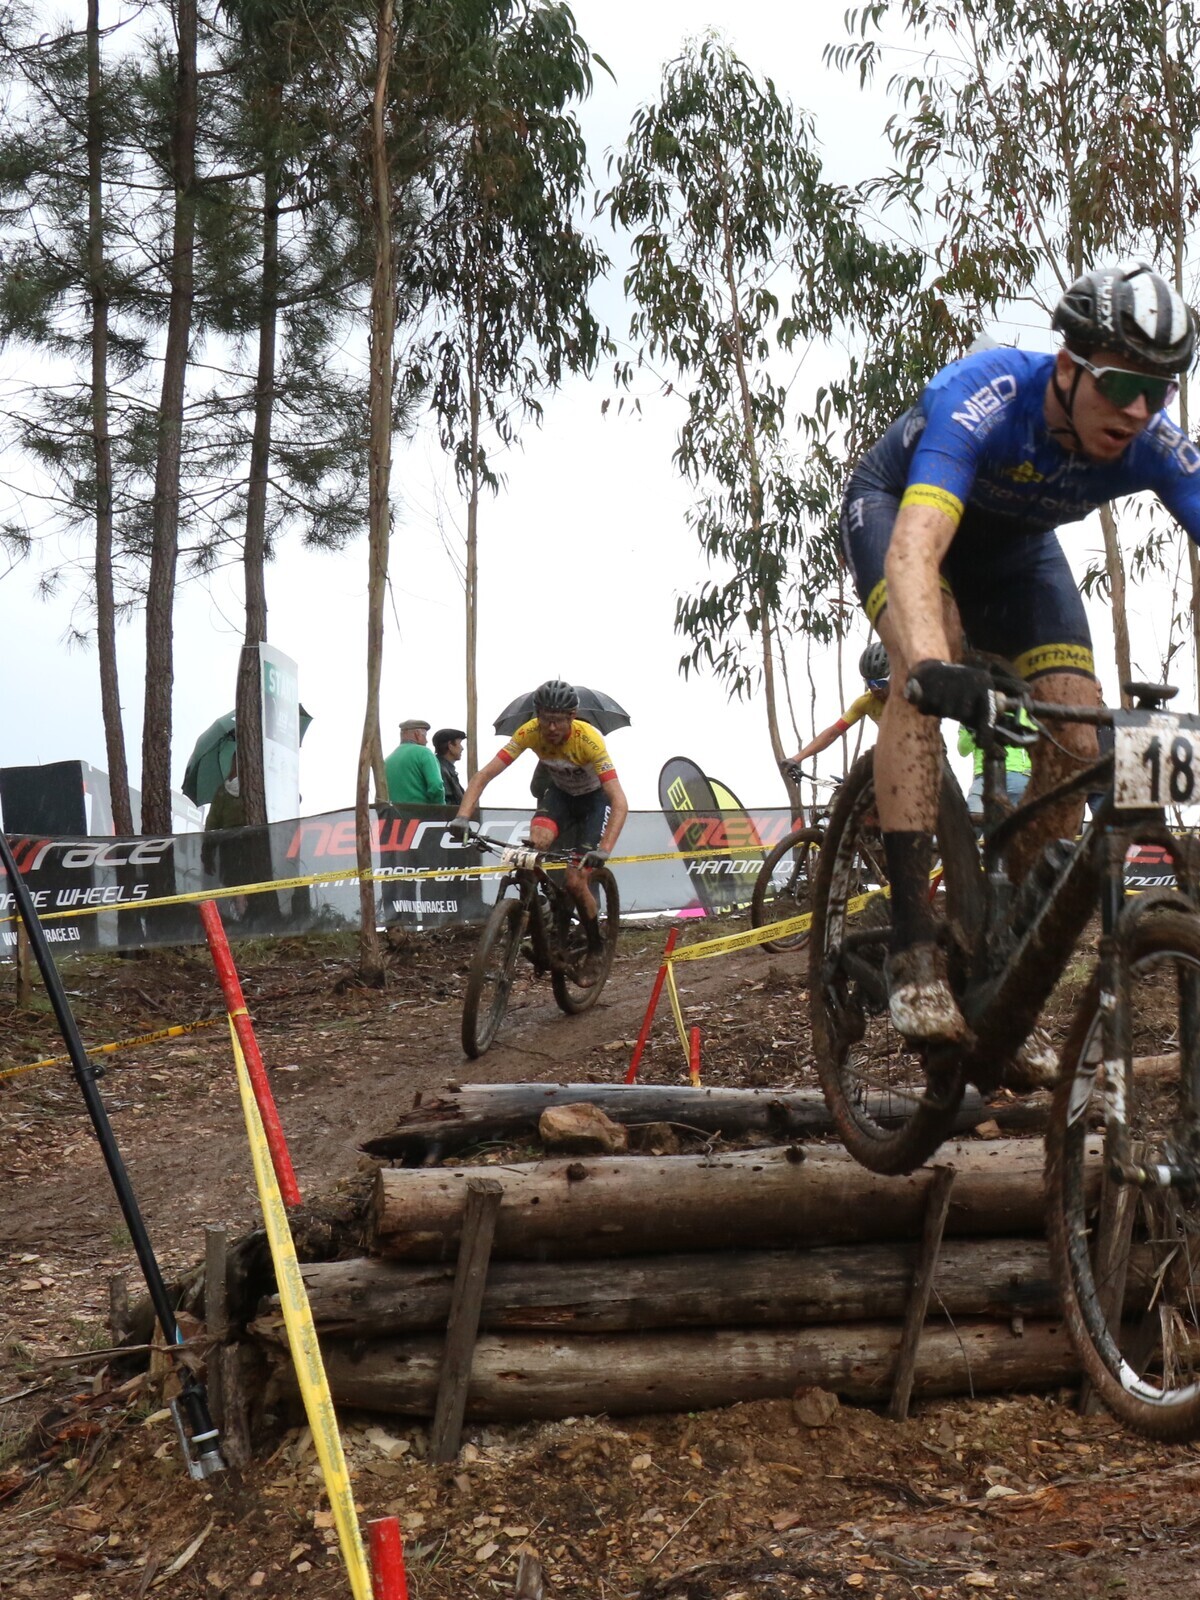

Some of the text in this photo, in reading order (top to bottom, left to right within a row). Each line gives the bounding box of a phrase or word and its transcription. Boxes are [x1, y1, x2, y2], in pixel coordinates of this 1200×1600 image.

[1143, 736, 1195, 802] 18
[56, 884, 149, 906] WHEELS
[392, 899, 459, 914] WWW.NEWRACE.EU
